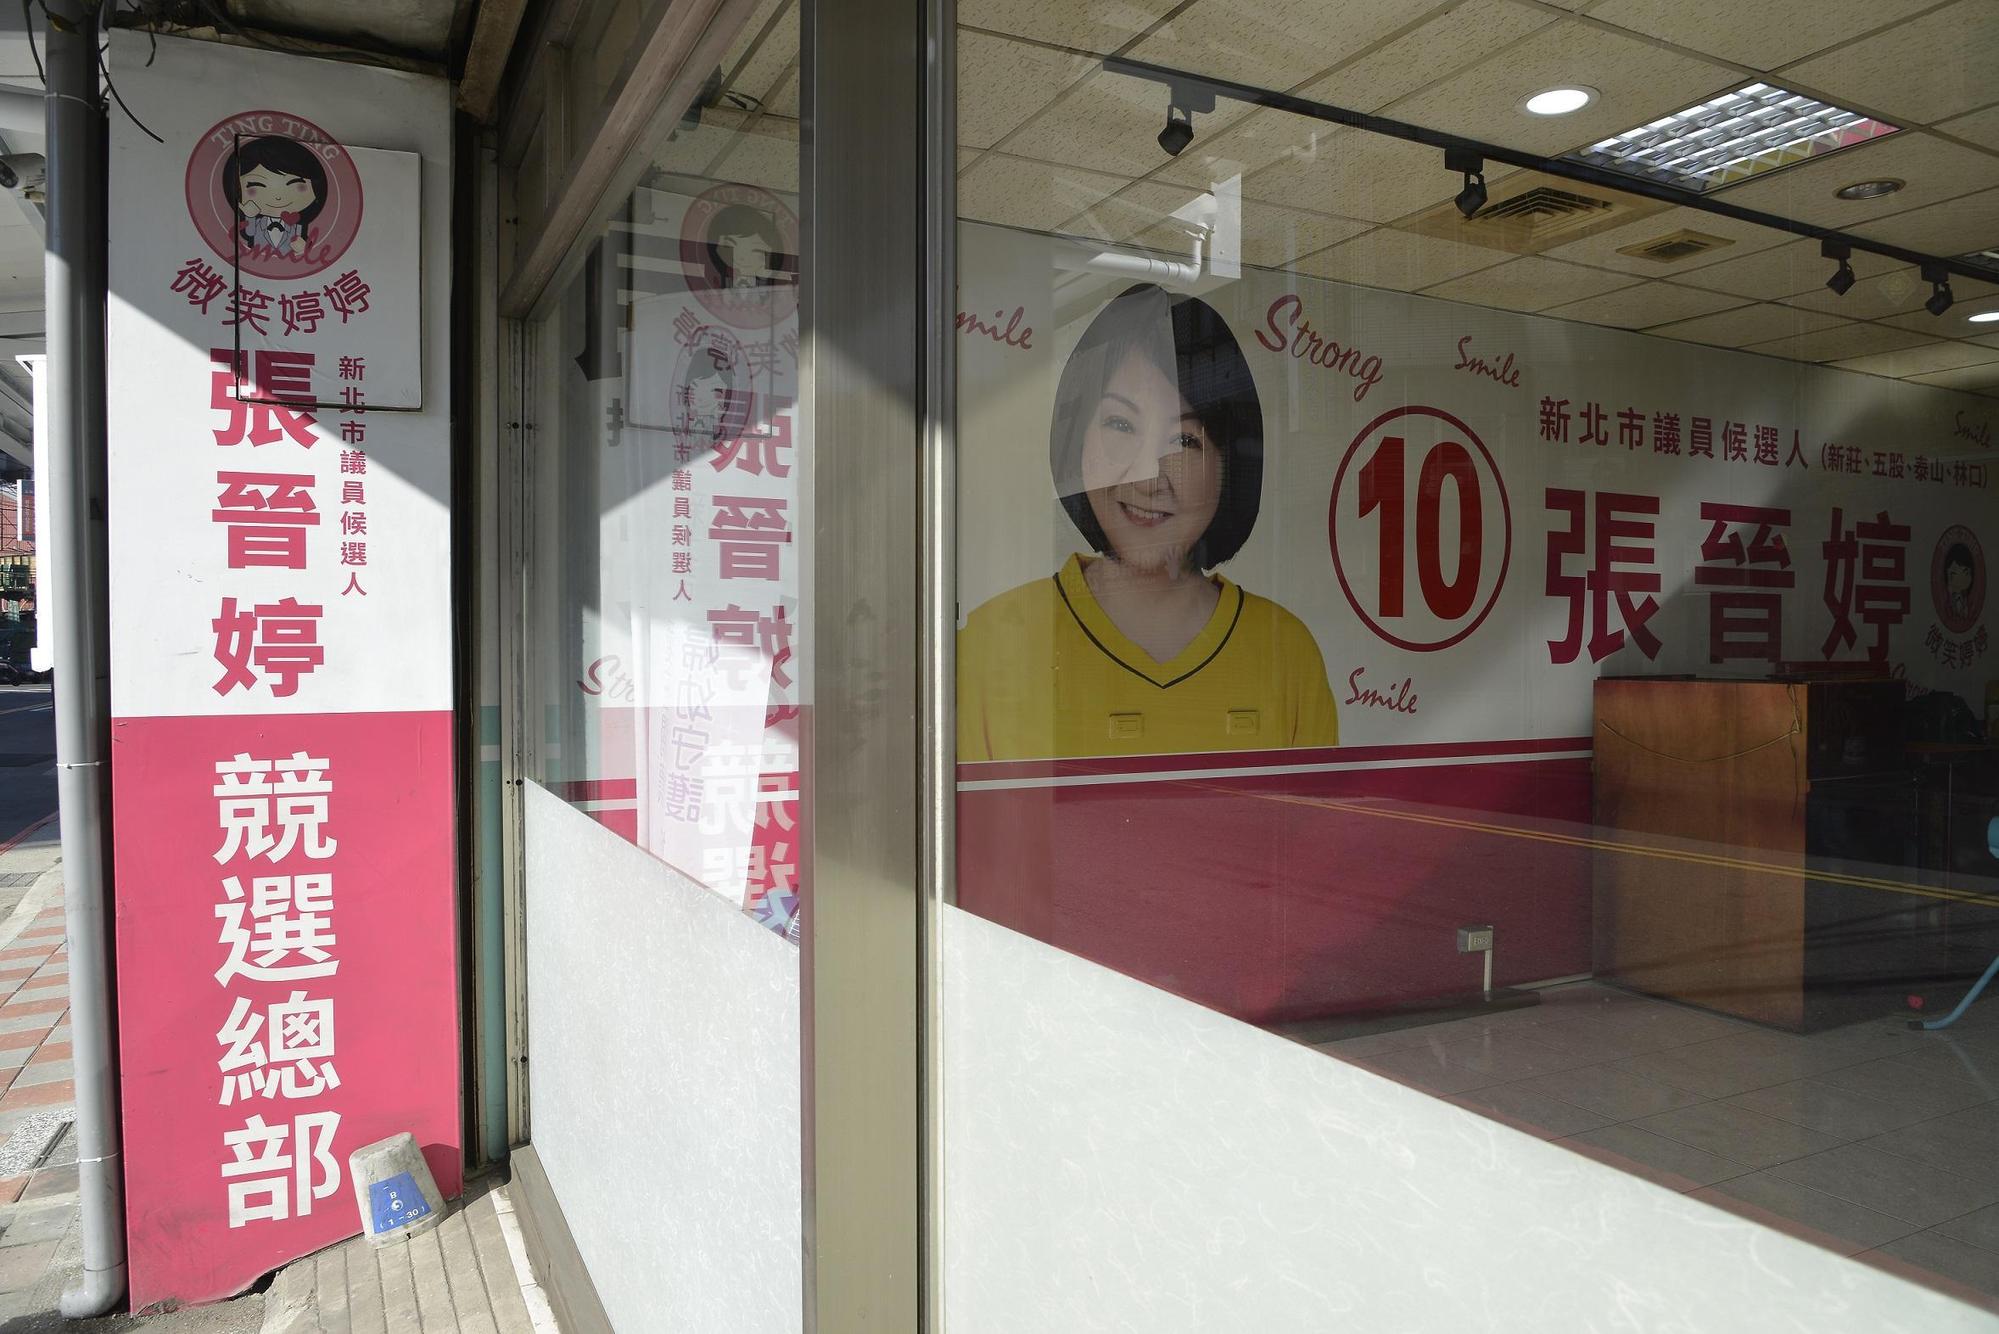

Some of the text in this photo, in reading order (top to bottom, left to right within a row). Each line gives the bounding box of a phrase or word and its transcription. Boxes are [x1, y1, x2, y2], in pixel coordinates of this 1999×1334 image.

[210, 114, 340, 161] TING TING
[226, 219, 334, 266] Smile
[170, 257, 371, 337] 微笑婷婷
[956, 306, 1034, 350] mile
[1255, 294, 1383, 401] Strong
[1454, 335, 1520, 388] Smile
[1539, 396, 1808, 469] 新北市議員候選人
[1955, 410, 1992, 447] Smile
[338, 355, 368, 597] 新北市議員候選人
[210, 348, 325, 698] 張晉婷
[1358, 436, 1484, 621] 10
[1545, 486, 1912, 665] 張晉婷
[1344, 667, 1420, 714] Smile
[213, 751, 342, 1229] 競選總部
